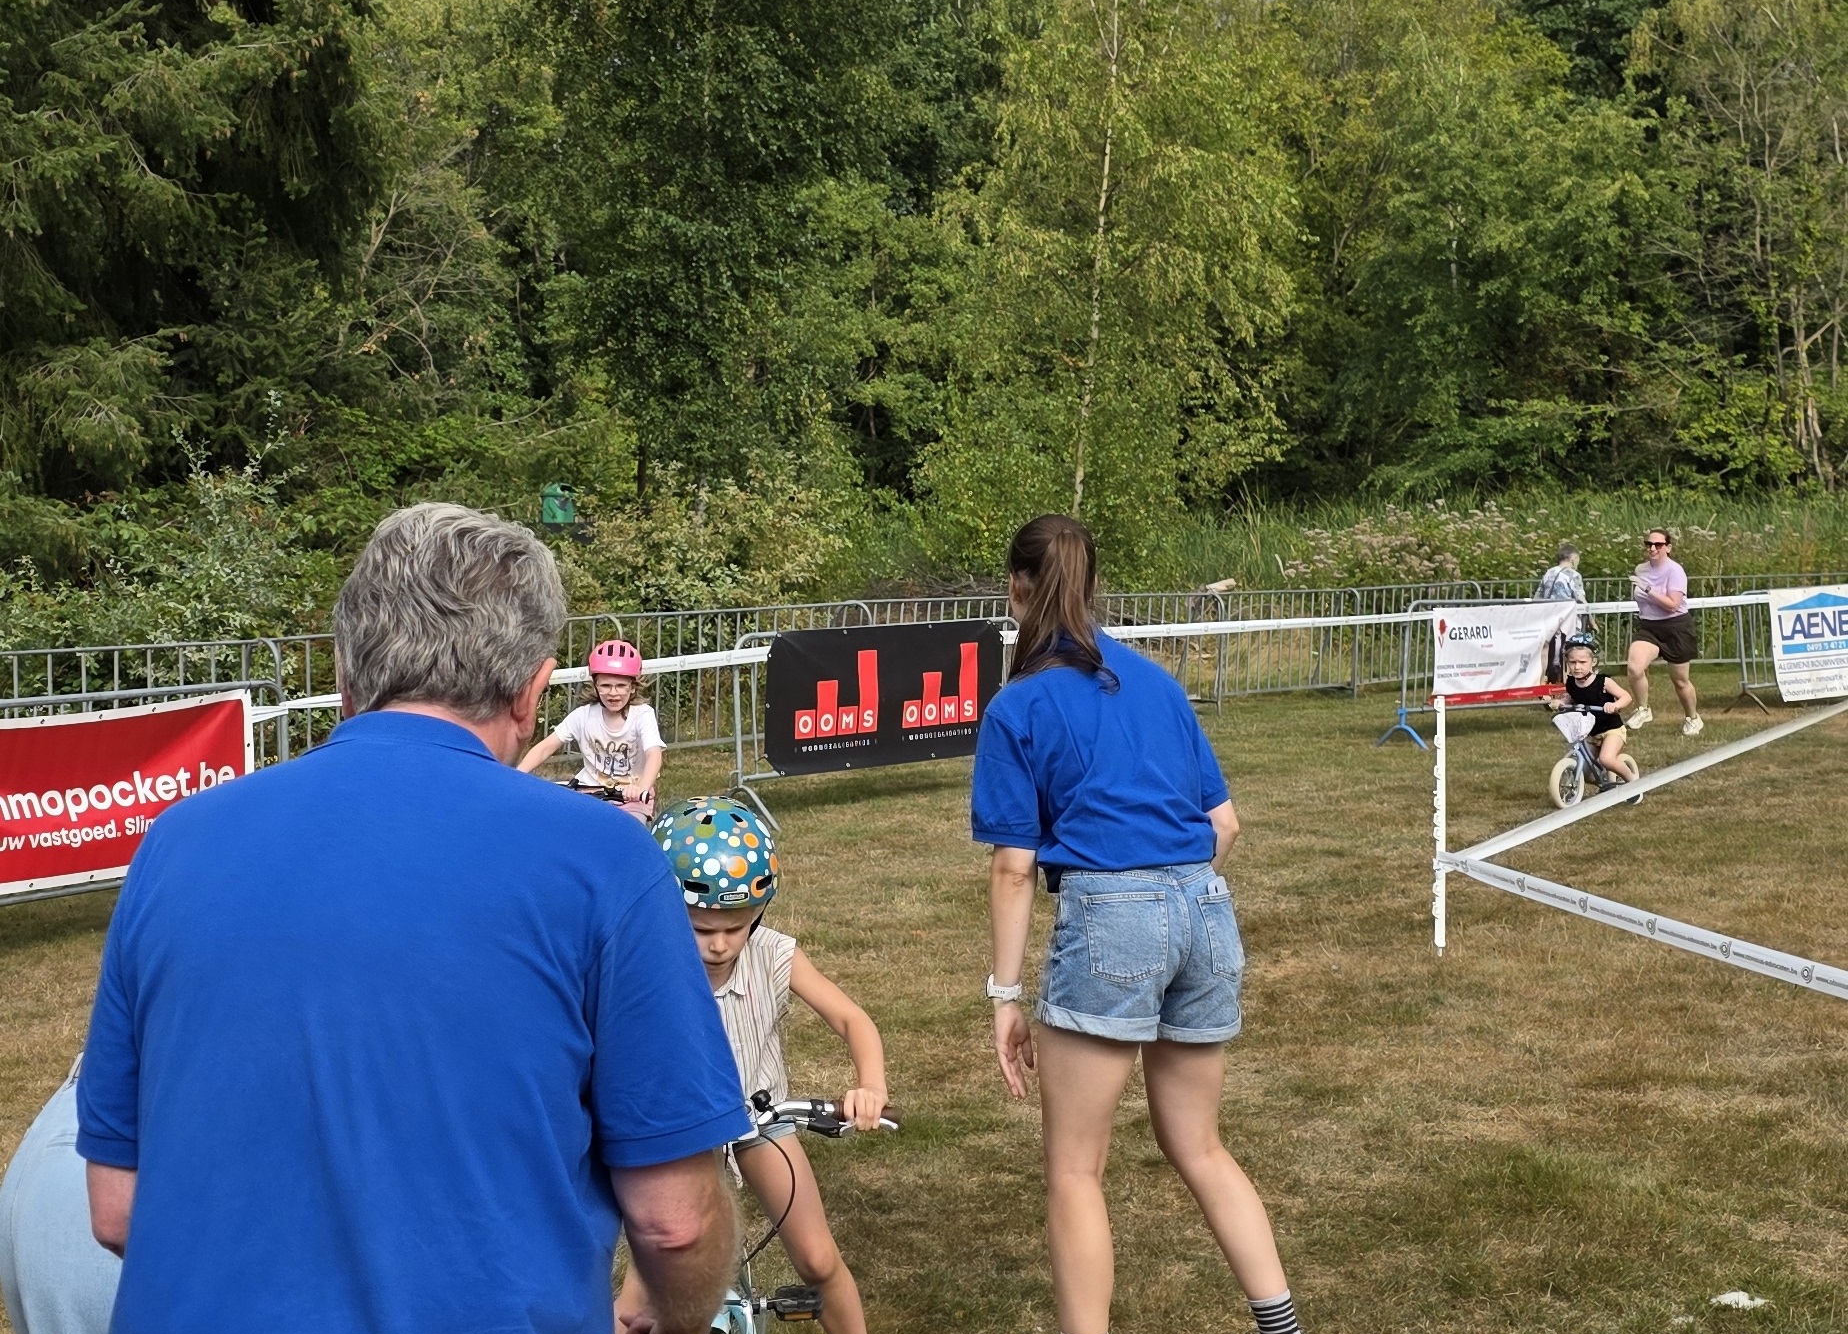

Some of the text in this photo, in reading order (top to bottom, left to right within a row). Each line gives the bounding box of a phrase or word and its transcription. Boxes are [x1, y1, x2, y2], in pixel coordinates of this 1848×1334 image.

[1449, 625, 1493, 641] GERARDI
[798, 709, 874, 734] OOMS
[905, 699, 974, 723] OOMS
[28, 819, 122, 849] vastgoed.
